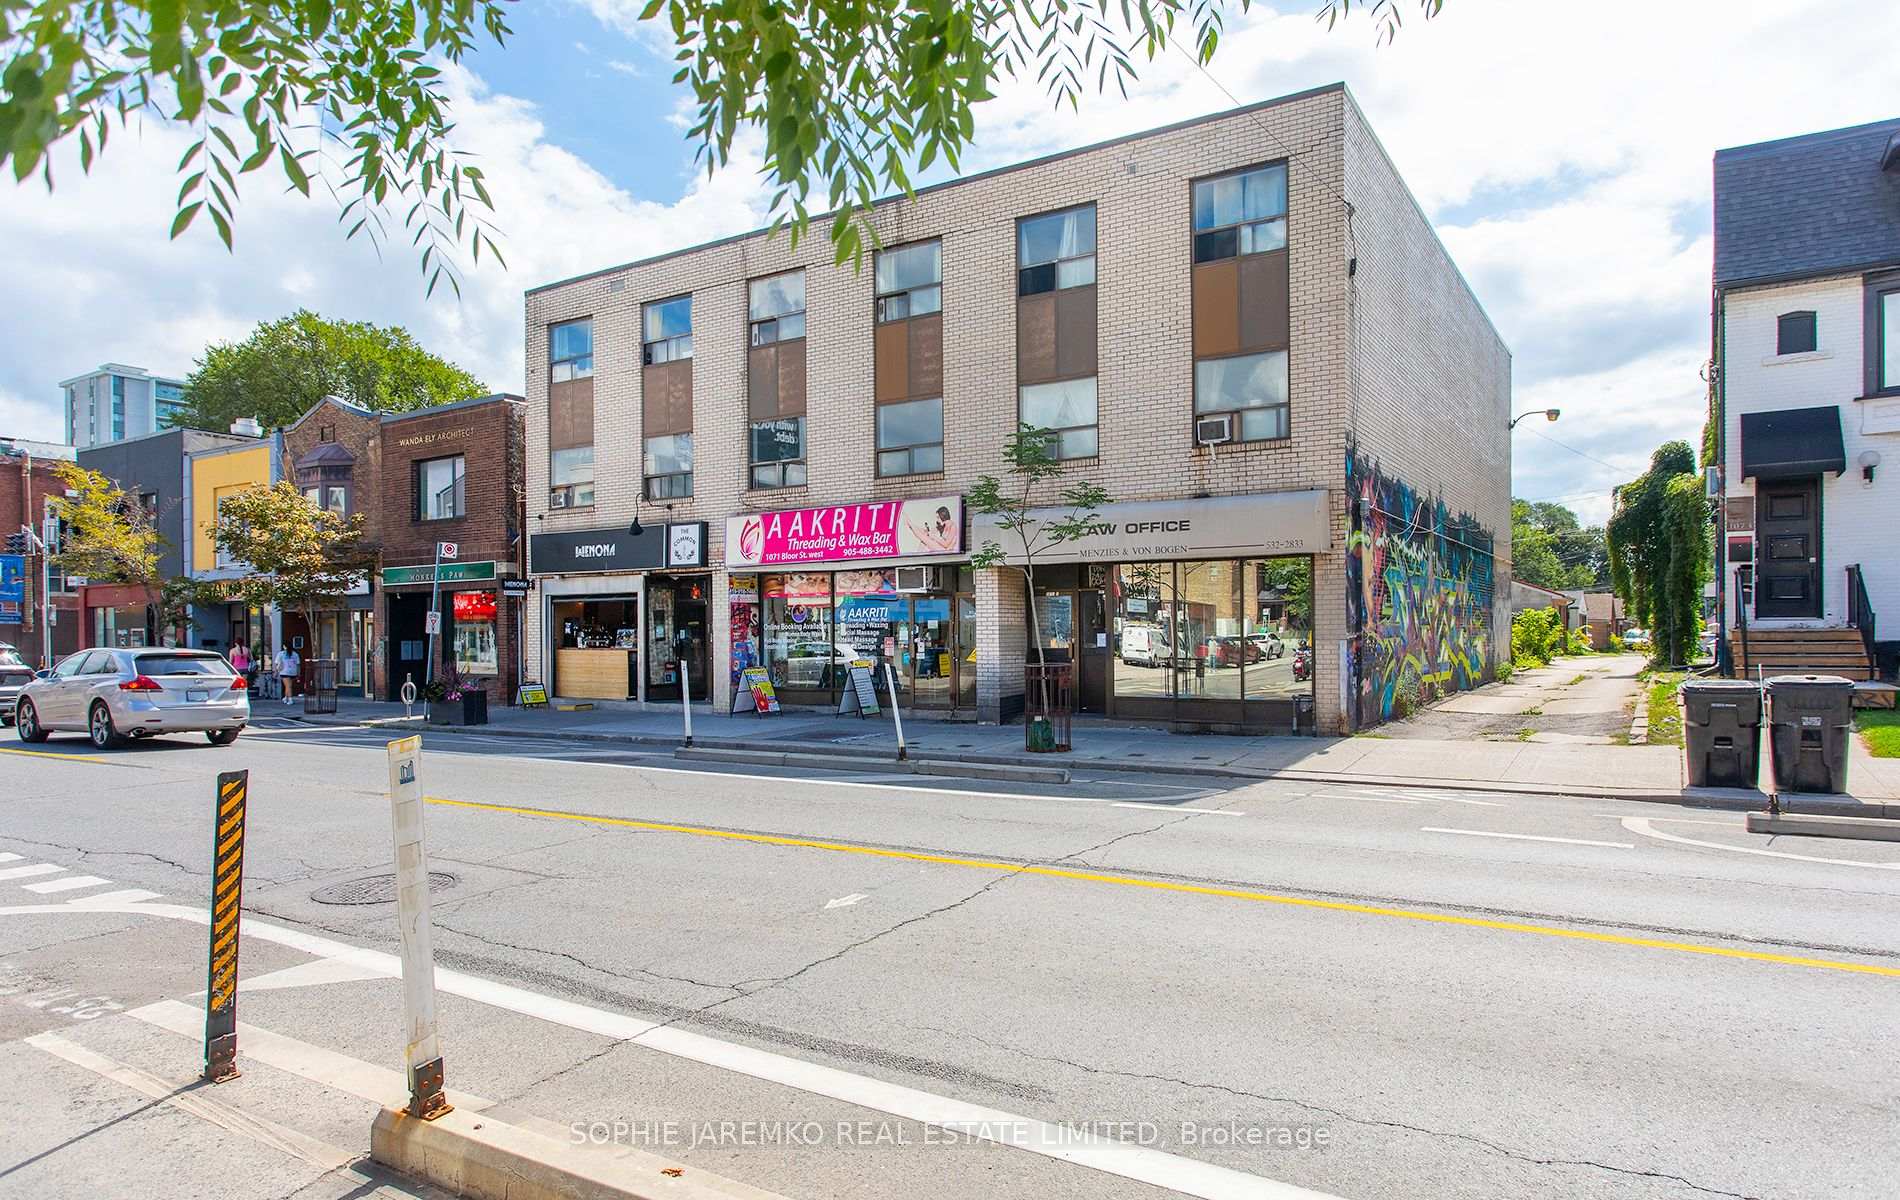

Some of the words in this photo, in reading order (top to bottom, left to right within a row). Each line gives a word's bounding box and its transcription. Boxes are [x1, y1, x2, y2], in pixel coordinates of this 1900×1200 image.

[400, 437, 423, 447] WANDA
[425, 434, 436, 443] ELY
[437, 427, 474, 440] ARCHITECT
[767, 503, 897, 539] AAKRITI
[1075, 524, 1117, 536] AW
[1125, 520, 1191, 534] OFFICE
[673, 536, 696, 546] COMMON
[788, 536, 837, 551] Threading
[838, 535, 846, 547] &
[848, 534, 870, 546] Wax
[873, 532, 891, 544] Bar
[1266, 539, 1304, 550] 532-2833
[575, 543, 616, 558] WENONA
[766, 553, 780, 561] 1071
[781, 552, 799, 560] Bloor
[799, 551, 808, 559] St.
[843, 545, 893, 557] 905-488-3442
[1080, 548, 1120, 558] MENZIES
[1122, 547, 1129, 556] &
[1132, 546, 1152, 555] VON
[1155, 545, 1188, 554] BOGEN
[848, 607, 888, 618] AAKRITI
